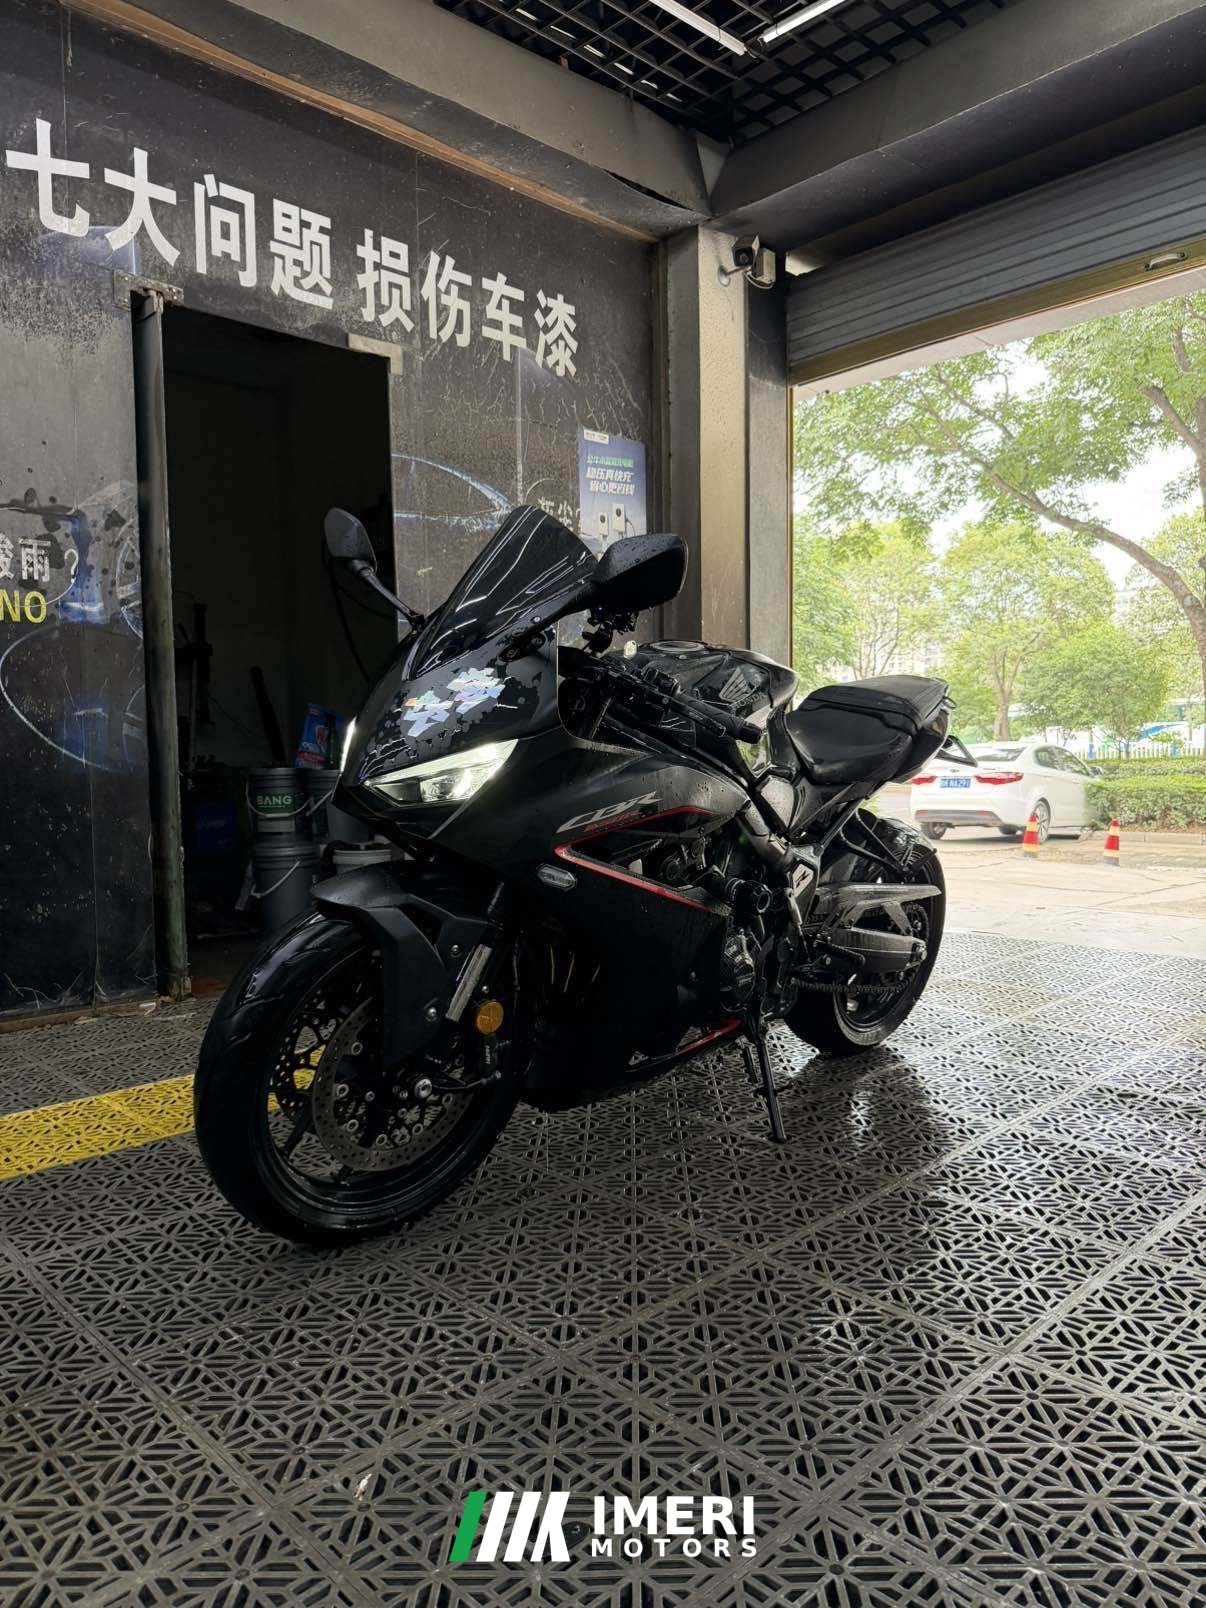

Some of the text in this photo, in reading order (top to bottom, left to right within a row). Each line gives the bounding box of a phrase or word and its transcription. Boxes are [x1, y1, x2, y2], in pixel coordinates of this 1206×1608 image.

[6, 118, 579, 377] 七大问题 损伤车漆
[0, 589, 47, 624] NO
[256, 795, 292, 805] BANG
